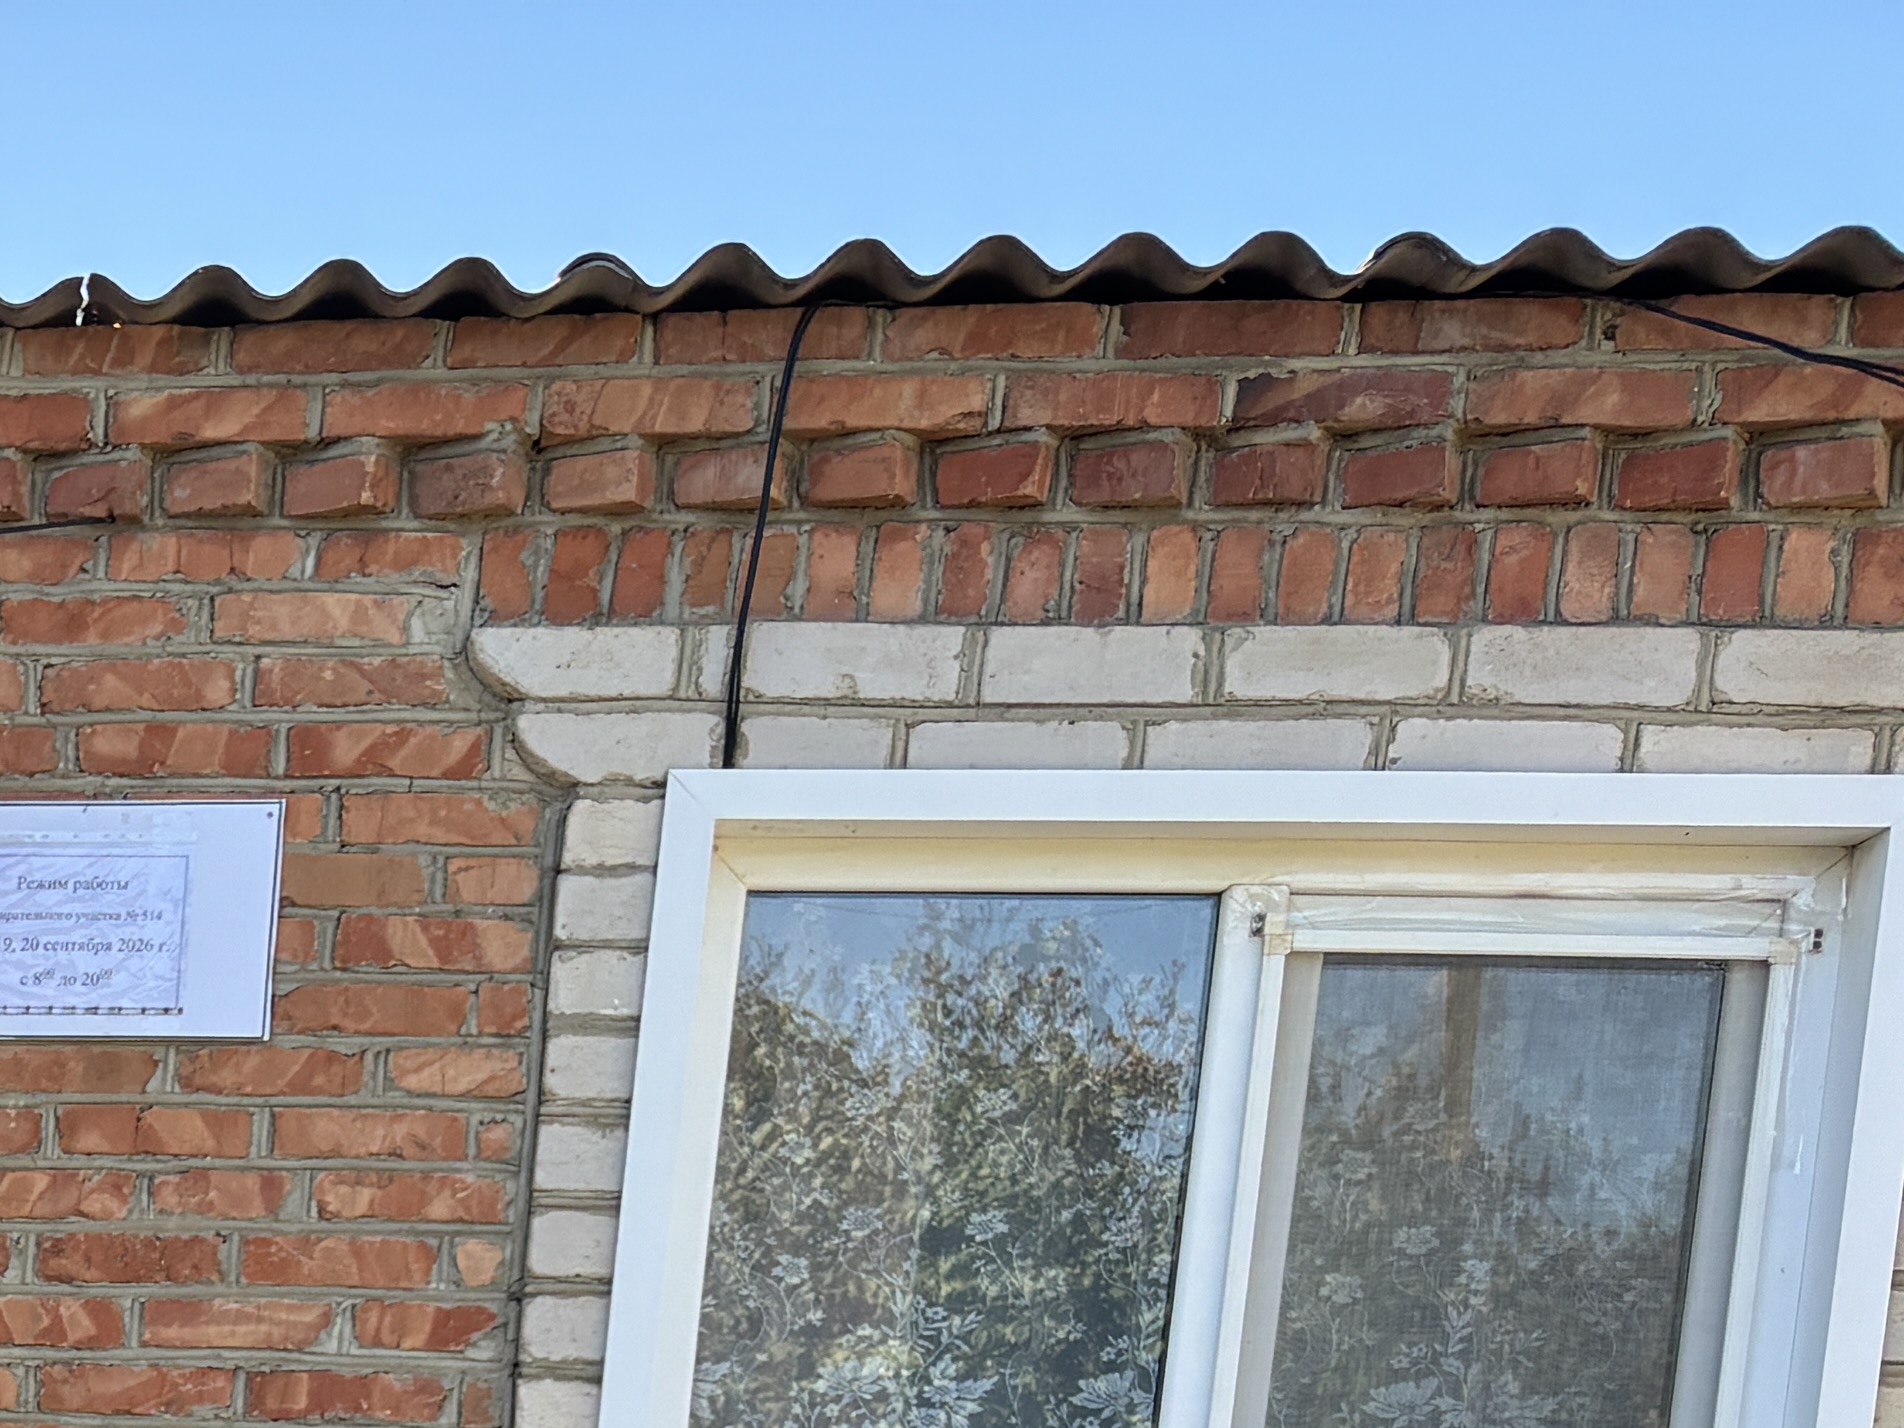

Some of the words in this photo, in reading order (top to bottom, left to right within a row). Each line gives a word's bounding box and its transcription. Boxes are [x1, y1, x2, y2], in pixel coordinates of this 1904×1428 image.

[16, 876, 69, 890] Режим
[72, 876, 130, 893] работы
[141, 909, 163, 921] 514
[20, 937, 40, 951] 20
[43, 938, 112, 955] сентября
[118, 938, 154, 951] 2026
[20, 977, 27, 985] с
[58, 976, 77, 986] до
